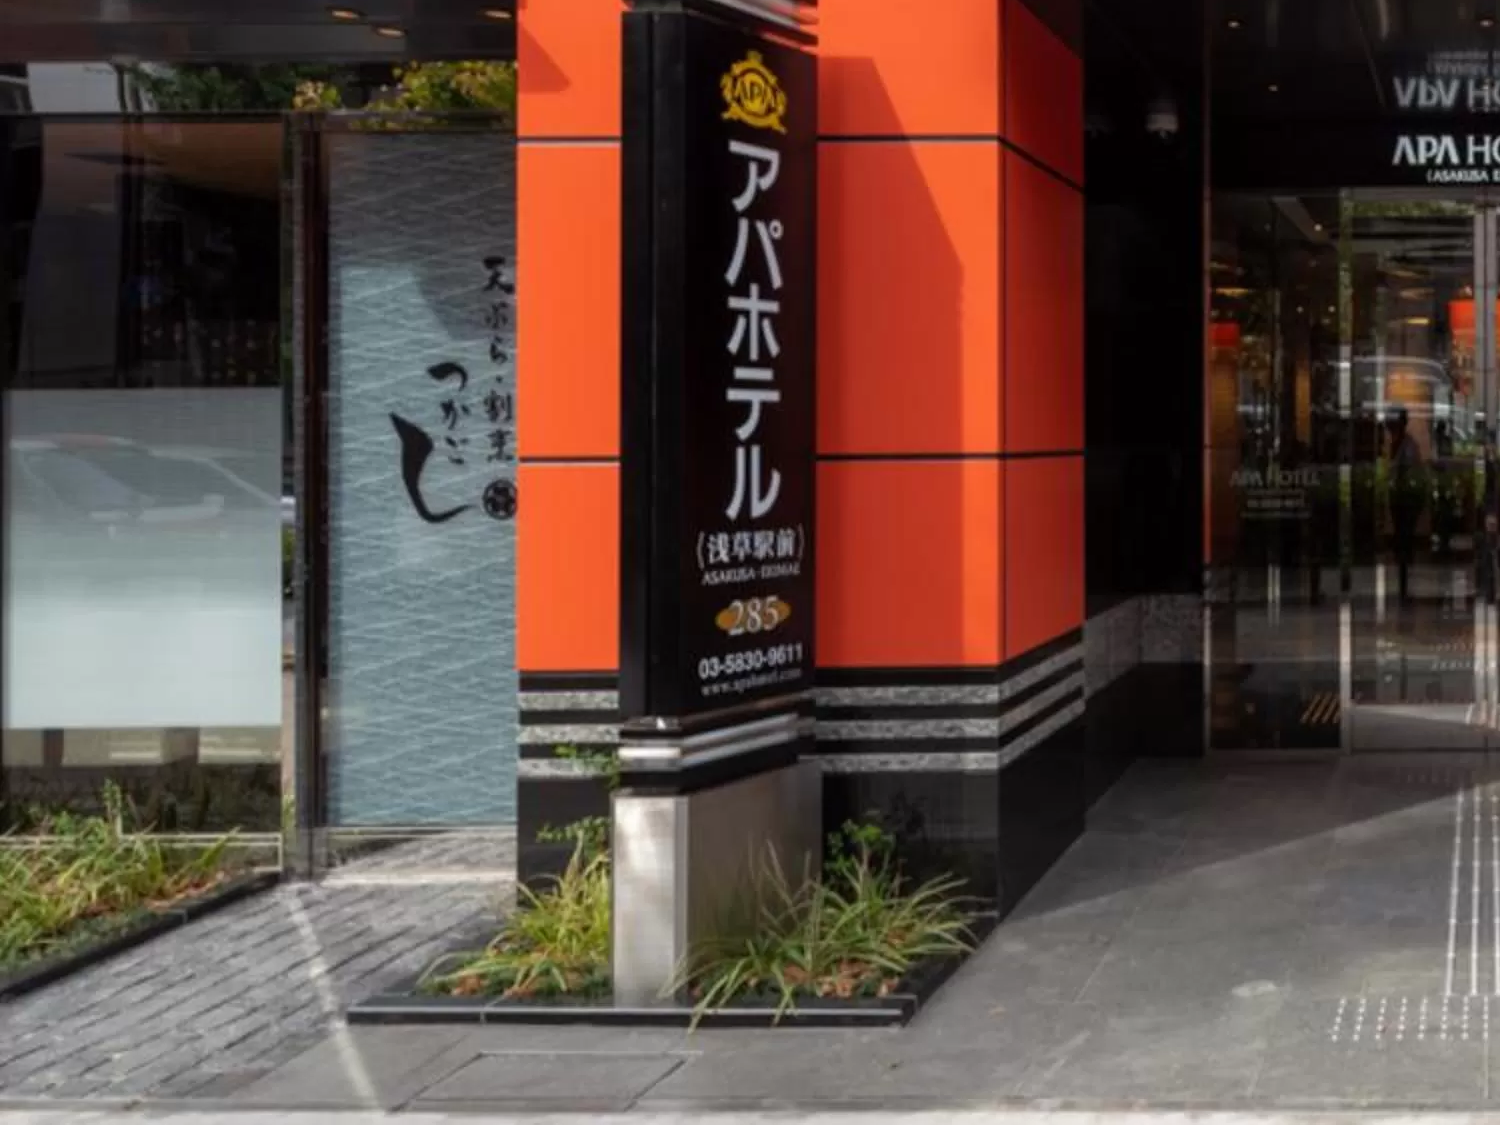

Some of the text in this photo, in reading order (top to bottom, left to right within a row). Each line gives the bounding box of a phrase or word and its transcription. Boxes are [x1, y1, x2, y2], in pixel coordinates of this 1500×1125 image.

[1392, 133, 1461, 166] APA
[723, 139, 783, 521] アパホテル
[727, 595, 780, 637] 285
[698, 642, 803, 680] 03-5830-9611
